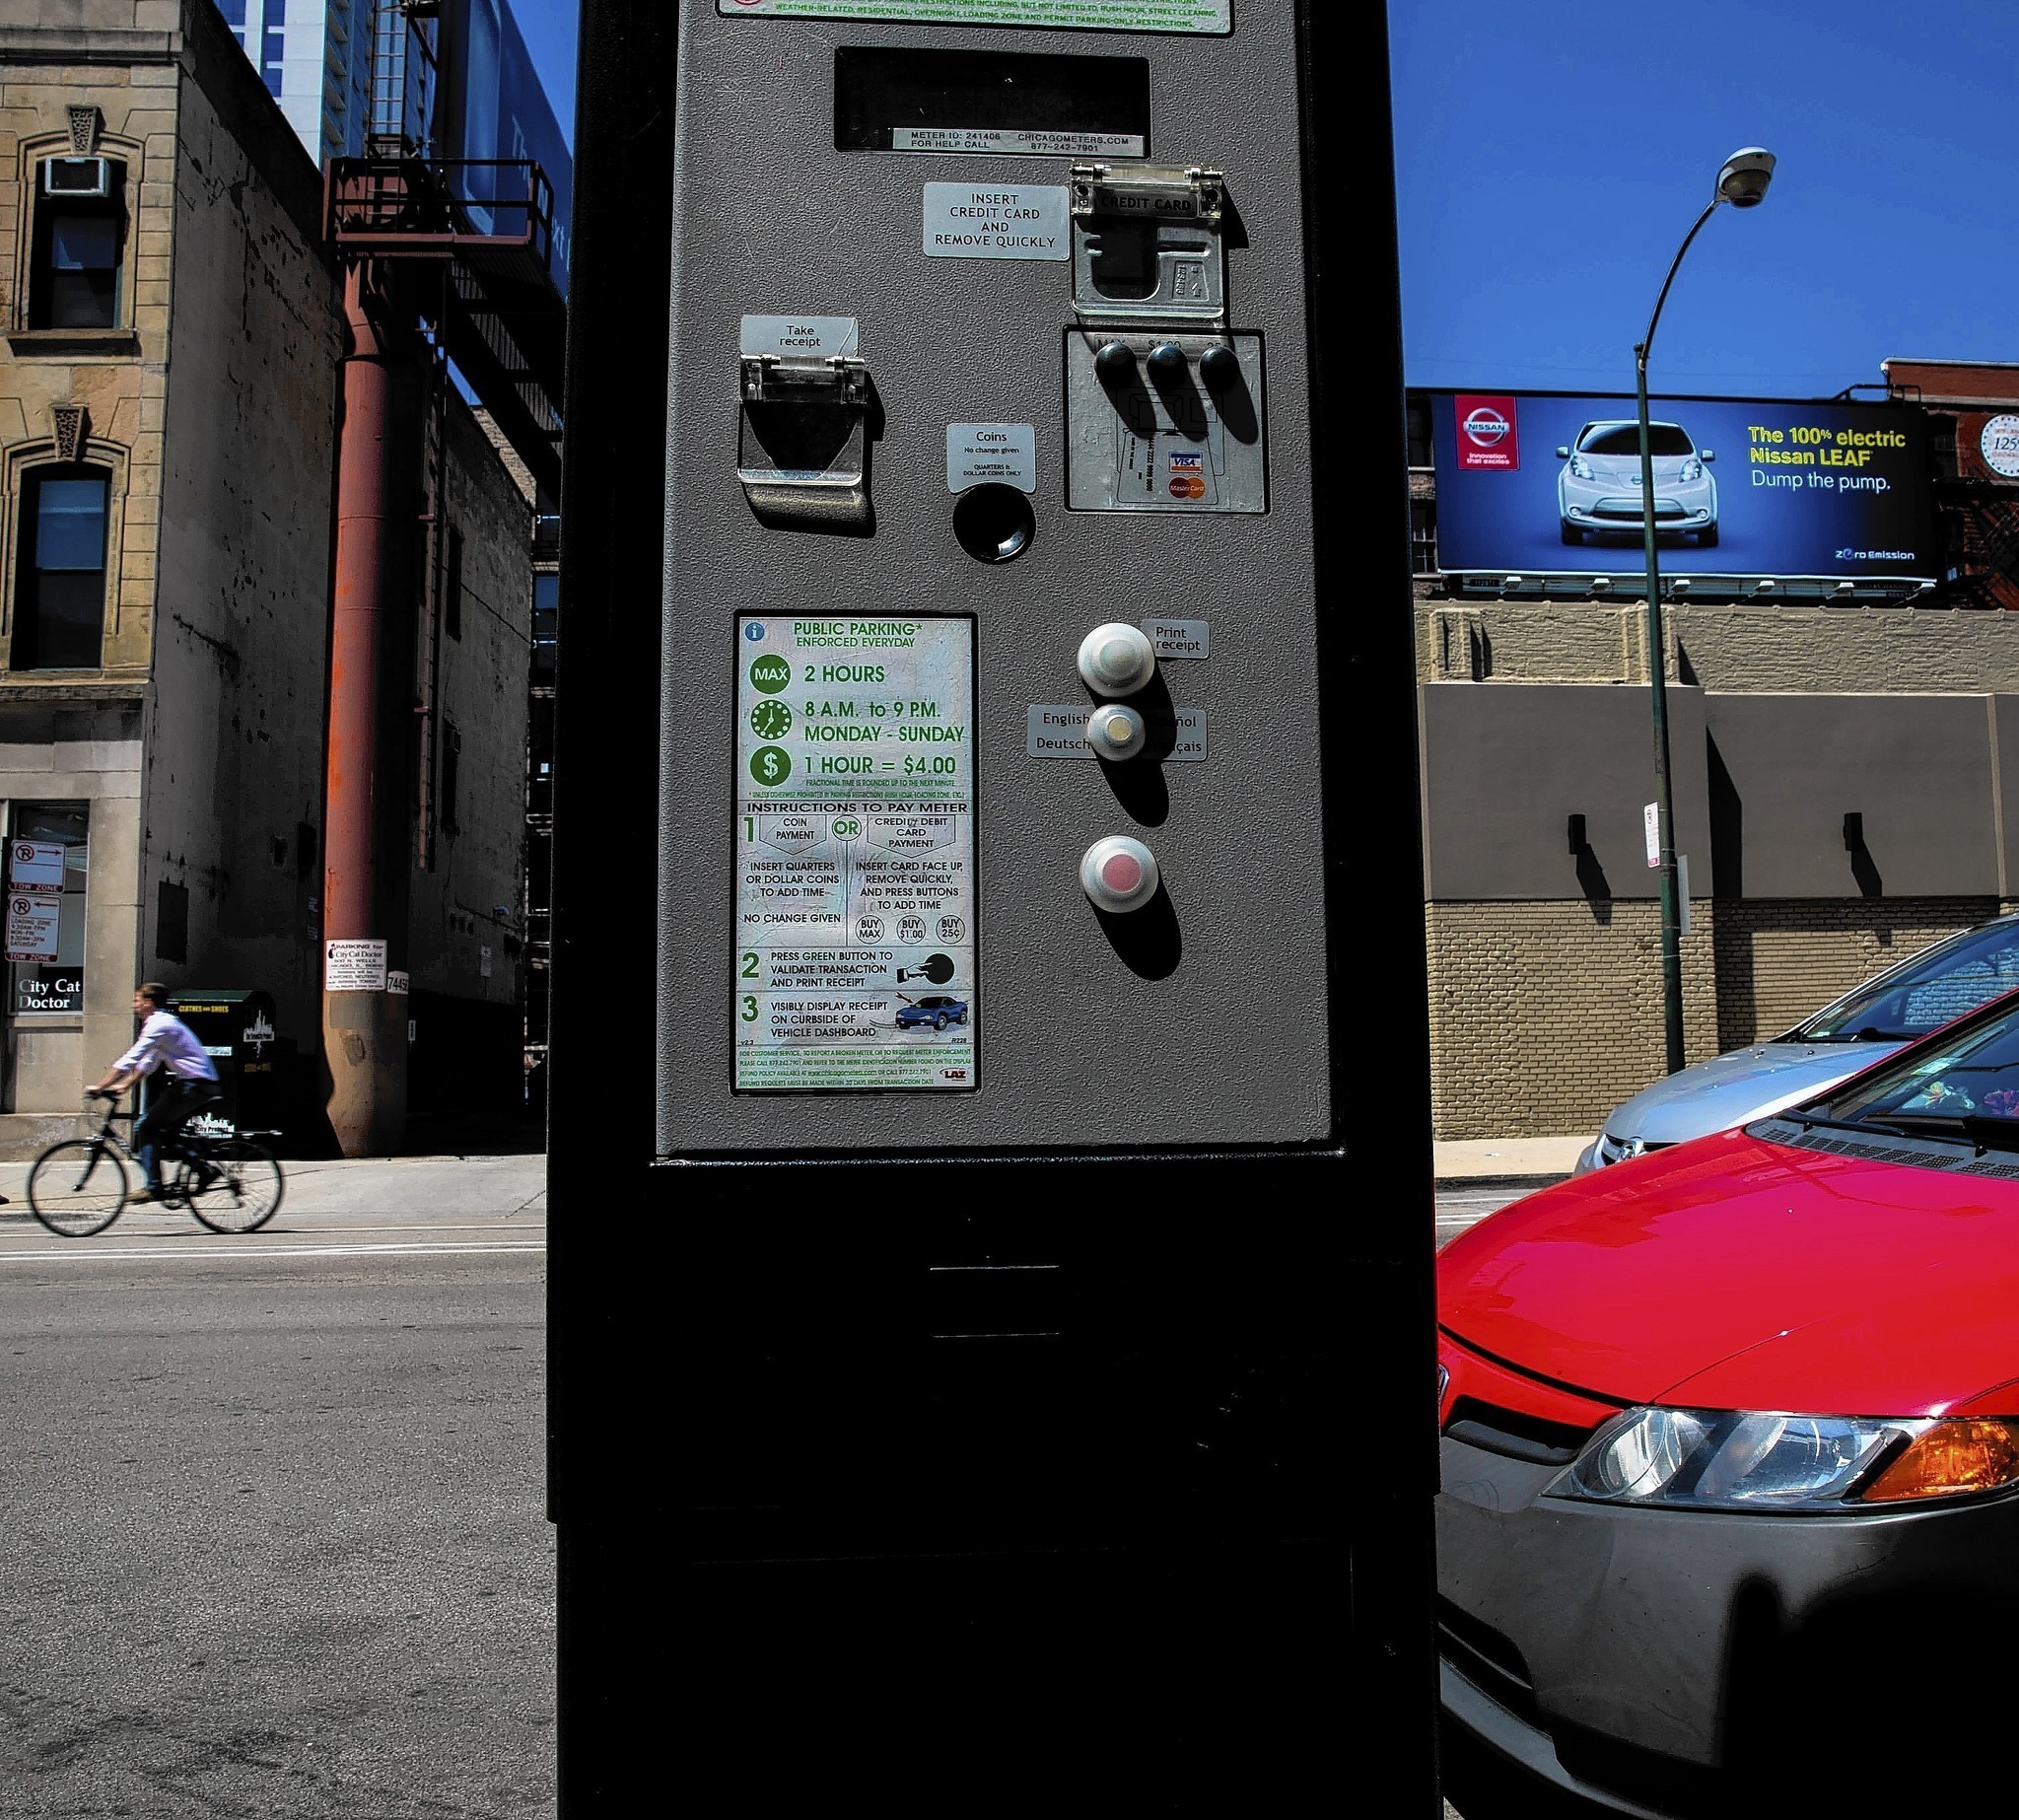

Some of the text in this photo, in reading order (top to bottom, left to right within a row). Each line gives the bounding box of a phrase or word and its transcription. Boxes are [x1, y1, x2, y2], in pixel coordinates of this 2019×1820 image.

[964, 10, 999, 19] LOADING
[1076, 16, 1134, 25] PARKING-ONLY
[1136, 18, 1194, 28] RESTRICTIONS.
[1178, 9, 1218, 18] CLEANING,
[1018, 133, 1129, 145] CHICAGOMETERS.COM
[1031, 143, 1098, 152] 877-242-7901
[971, 193, 1019, 205] INSERT
[1100, 197, 1192, 211] CREDIT CARD
[949, 207, 1041, 219] CREDIT CARD
[981, 222, 1009, 232] AND
[935, 235, 1056, 248] REMOVE QUICKLY
[786, 325, 815, 336] Take
[779, 336, 821, 349] receipt
[975, 431, 1008, 442] Coins
[1748, 426, 1906, 447] The 100% electric
[975, 447, 998, 455] change
[1000, 447, 1019, 456] given
[1750, 447, 1871, 466] Nissan LEAF
[1752, 470, 1891, 495] Dump the pump.
[794, 622, 845, 635] PUBLIC
[1155, 627, 1186, 638] Print
[797, 637, 915, 647] ENFORCED EVERYDAY
[1155, 639, 1201, 653] receipt
[754, 667, 788, 680] MAX
[804, 665, 885, 682] 2 HOURS
[805, 701, 815, 717] 8
[821, 701, 859, 717] A.M.
[870, 701, 886, 717] to
[894, 701, 904, 717] 9
[1043, 713, 1090, 727] English
[805, 726, 964, 741] MONDAY SUNDAY
[1037, 737, 1091, 750] Deutsch
[805, 755, 956, 775] 1 HOUR $4.00
[747, 803, 968, 812] INSTRUCTIONS TO PAY METER
[783, 818, 807, 827] COIN
[834, 821, 859, 835] OR
[744, 817, 754, 842] 1
[896, 828, 926, 837] CARD
[776, 831, 815, 840] PAYMENT
[889, 840, 934, 848] PAYMENT
[750, 862, 835, 872] INSERT QUARTERS
[856, 862, 964, 873] INSERT CARD FACE UP,
[746, 875, 839, 884] OR DOLLAR COINS
[866, 875, 954, 886] REMOVE QUICKLY,
[860, 888, 959, 897] AND PRESS BUTTONS
[744, 914, 841, 923] NO CHANGE GIVEN
[771, 952, 893, 961] PRESS GREEN BUTTON TO
[741, 952, 760, 978] 2
[771, 965, 887, 974] VALIDATE TRANSACTION
[19, 979, 80, 996] City Cat
[771, 978, 866, 987] AND PRINT RECEIPT
[20, 996, 70, 1009] Doctor
[771, 1002, 888, 1011] VISIBLY DISPLAY RECEIPT
[741, 995, 759, 1022] 3
[771, 1015, 856, 1024] ON CURBSIDE OF
[771, 1028, 876, 1037] VEHICLE DASHBOARD
